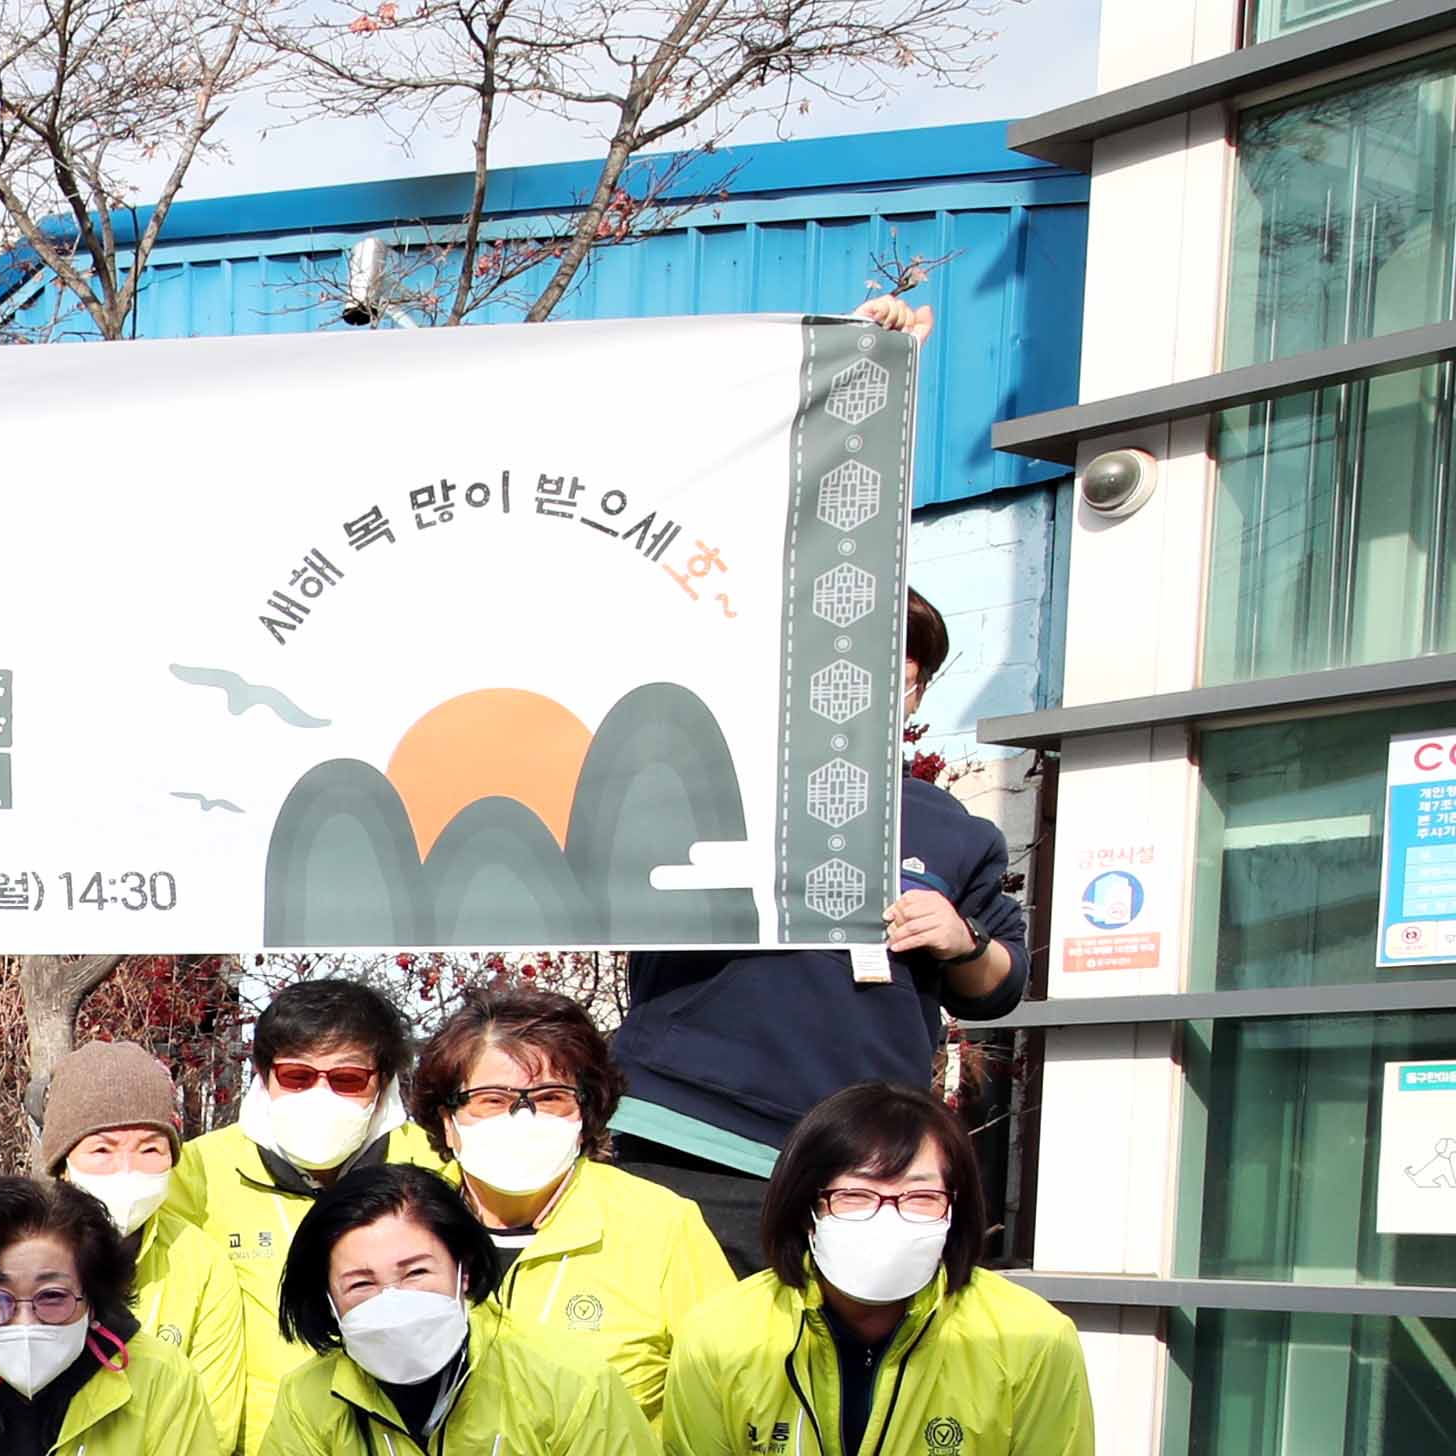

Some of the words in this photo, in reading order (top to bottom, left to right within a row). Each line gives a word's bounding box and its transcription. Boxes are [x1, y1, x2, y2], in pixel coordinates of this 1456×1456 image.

[258, 547, 344, 646] 새해
[342, 504, 396, 551] 복
[409, 470, 510, 530] 많이
[534, 472, 738, 618] 받으세호~
[59, 872, 178, 912] 14:30
